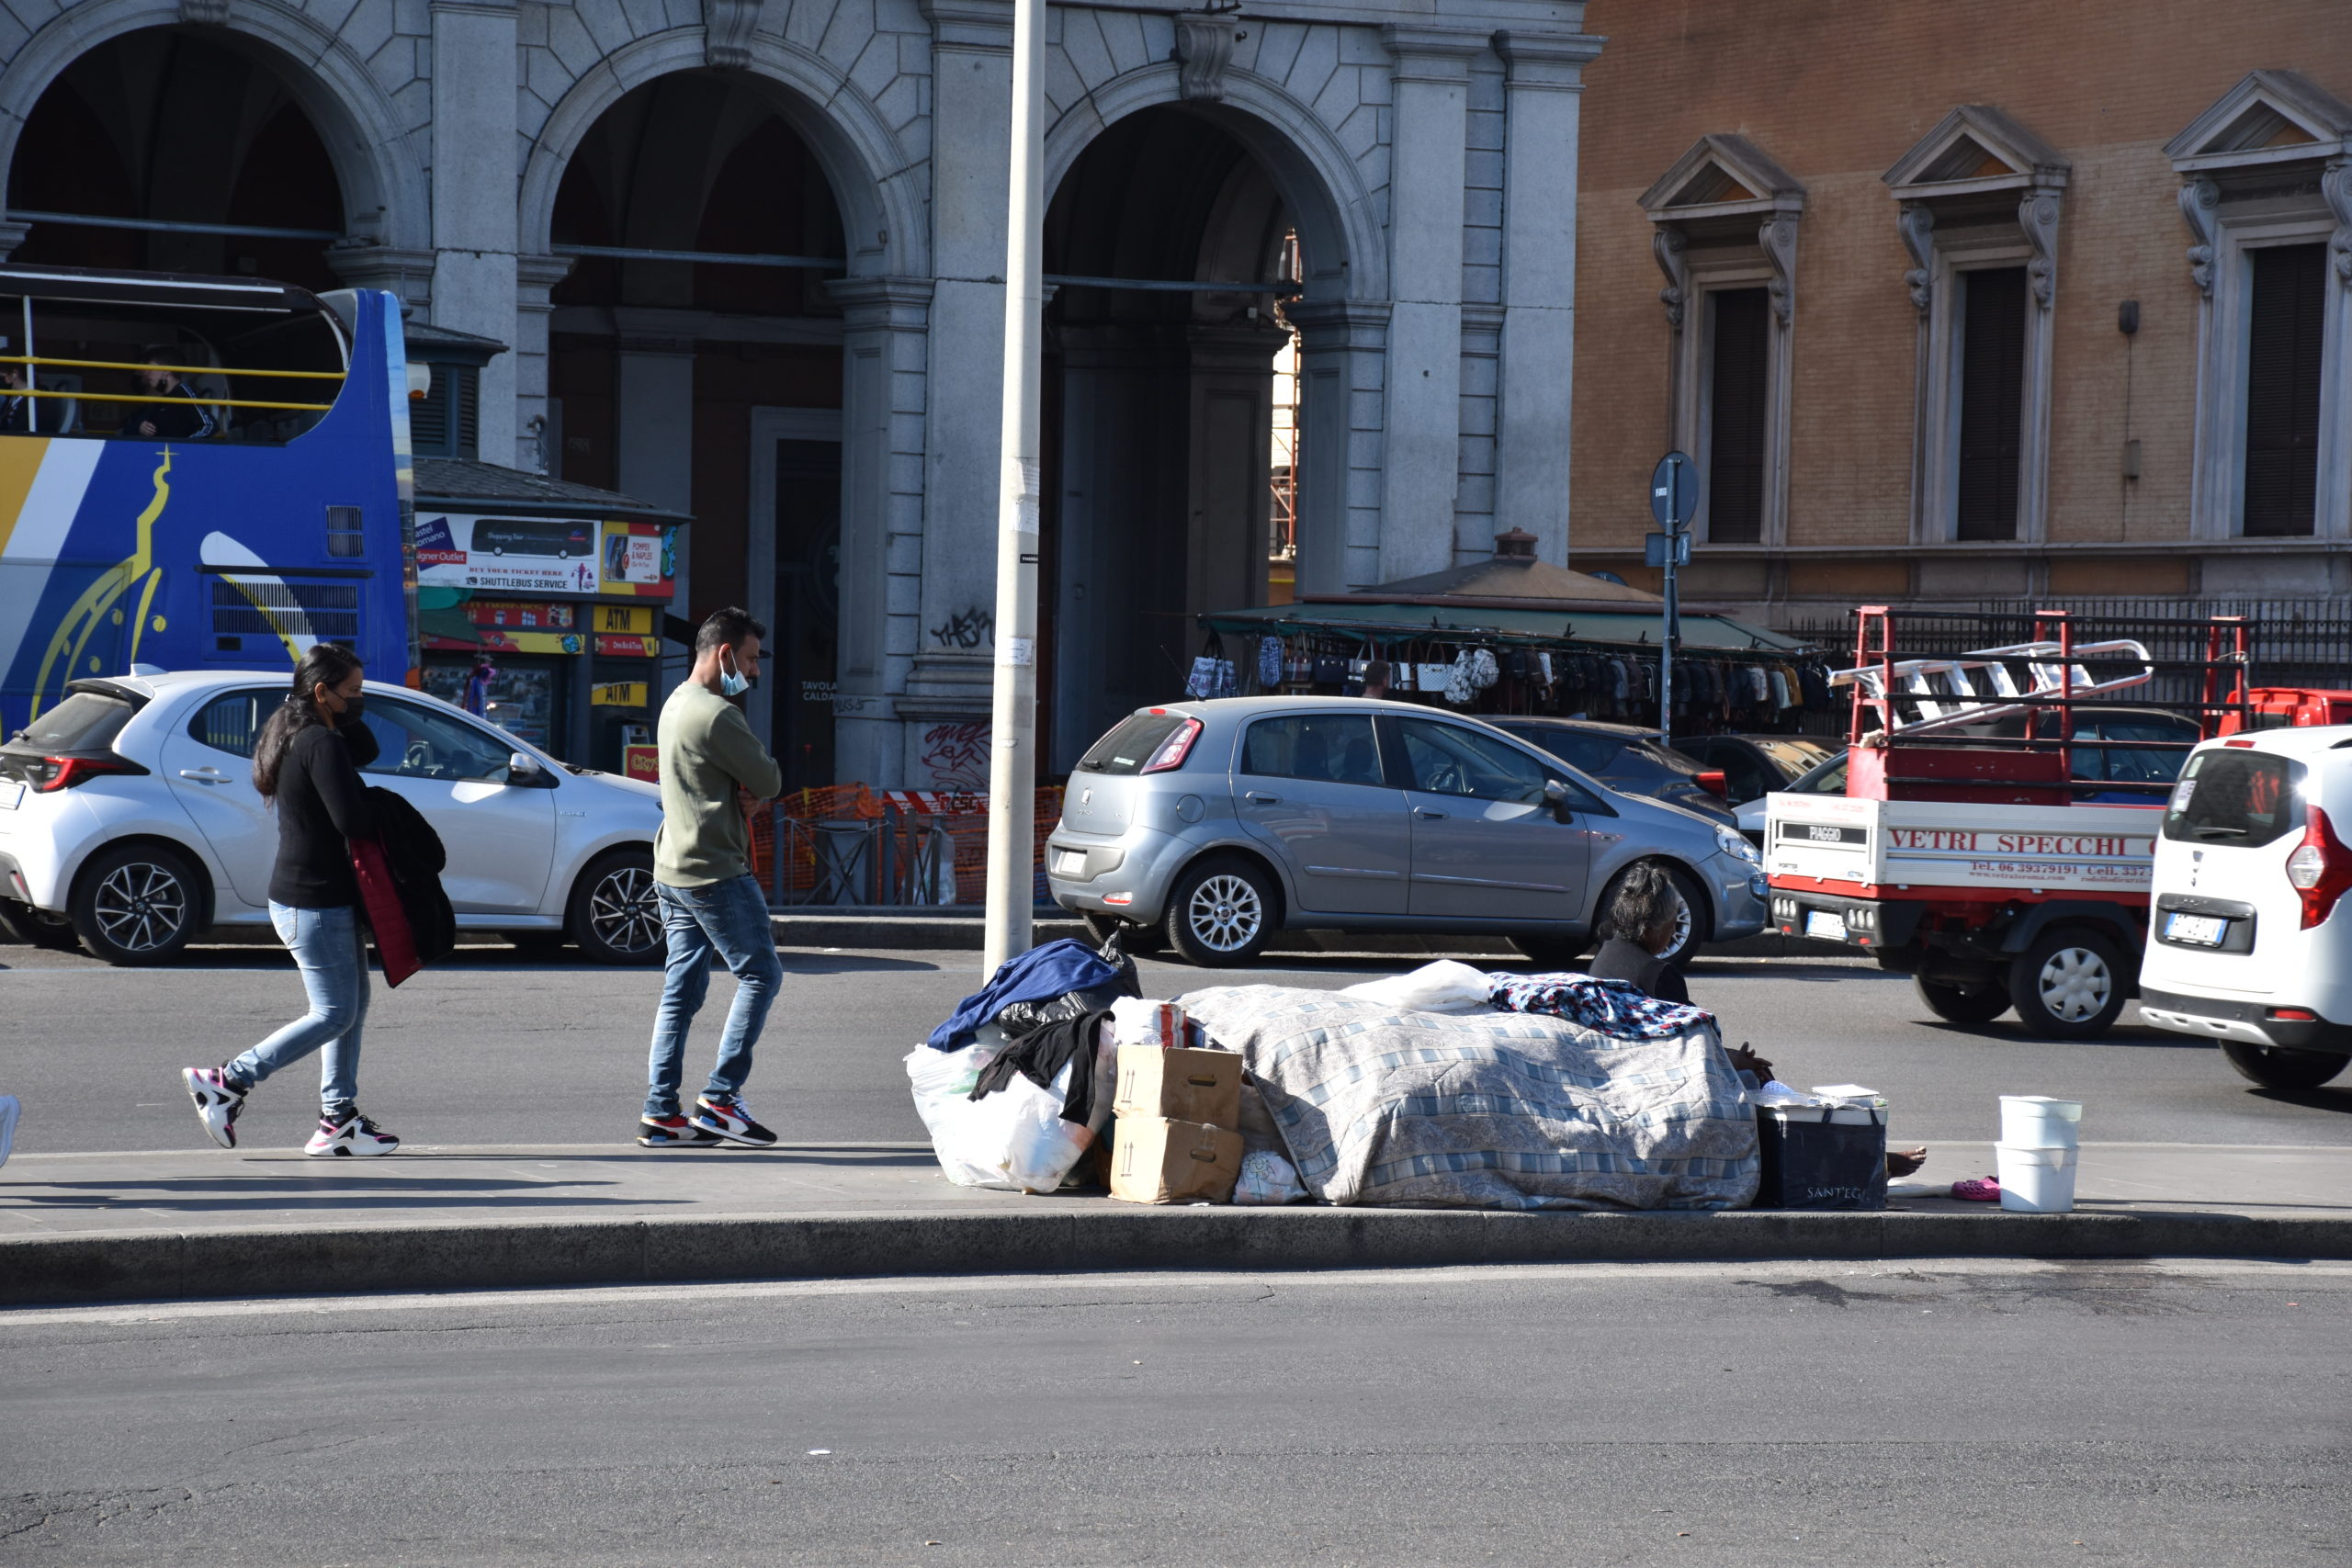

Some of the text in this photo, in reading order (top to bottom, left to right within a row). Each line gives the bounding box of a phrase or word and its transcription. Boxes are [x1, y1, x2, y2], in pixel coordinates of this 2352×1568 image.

[415, 524, 434, 538] astel
[487, 532, 512, 541] Shopping
[416, 531, 446, 547] omano
[438, 552, 464, 562] Outlet
[480, 576, 568, 590] SHUTTLEBUS SERVICE
[605, 607, 631, 631] ATM
[605, 683, 631, 702] ATM
[801, 681, 838, 691] TAVOLA
[802, 691, 834, 701] CALDA
[1809, 826, 1841, 841] PIAGGIO
[1891, 829, 1977, 851] VETRI
[1997, 833, 2125, 856] SPECCHI
[1970, 860, 1995, 871] Tel.
[1998, 862, 2014, 873] 06
[2017, 863, 2077, 874] 39379191
[2086, 865, 2118, 876] Cell.
[2122, 866, 2144, 876] 337
